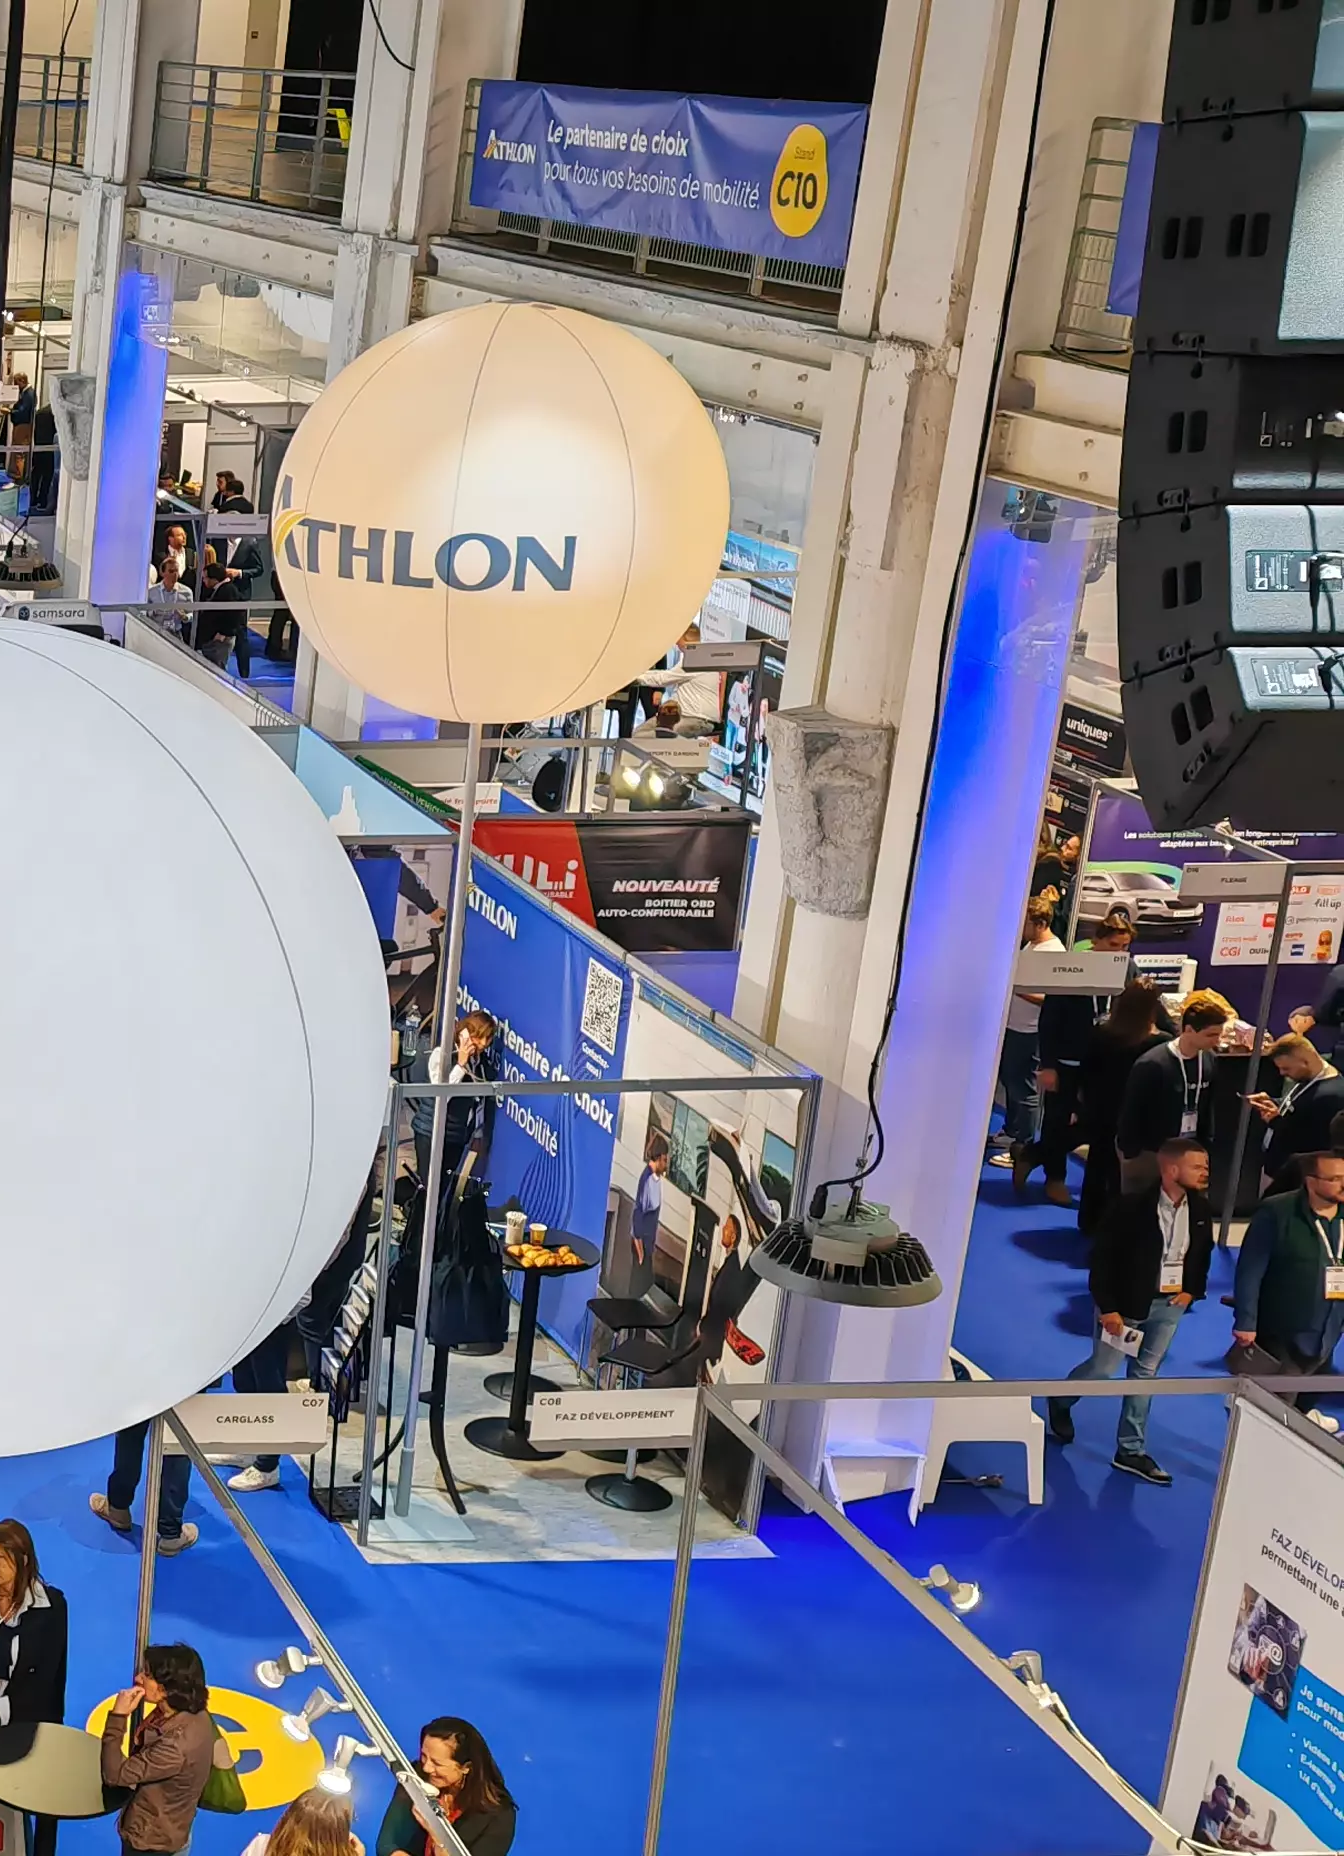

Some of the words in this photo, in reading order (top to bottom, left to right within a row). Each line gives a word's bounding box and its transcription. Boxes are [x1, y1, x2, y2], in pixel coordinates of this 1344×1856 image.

[483, 129, 536, 165] ATHLON
[548, 119, 562, 143] Le
[564, 126, 627, 152] partenaire
[630, 130, 647, 152] de
[652, 131, 689, 157] choix
[544, 160, 571, 185] pour
[572, 160, 598, 186] tous
[602, 169, 624, 189] vos
[627, 166, 676, 197] besoins
[680, 175, 700, 199] de
[704, 179, 760, 210] mobilité.
[777, 171, 818, 210] C10
[274, 474, 577, 592] ATHLON
[33, 608, 85, 619] samsara
[1124, 831, 1137, 840] Les
[612, 877, 720, 893] NOUVEAUTÉ
[597, 908, 714, 918] AUTO-CONFIGURABLE
[645, 899, 688, 908] BOITIER
[691, 899, 715, 908] OBD
[1330, 900, 1342, 910] up
[456, 984, 480, 1011] otre
[507, 1096, 558, 1158] mobilité
[302, 1398, 325, 1408] C07
[539, 1397, 562, 1406] C08
[216, 1415, 275, 1424] CARGLASS
[555, 1412, 577, 1422] FAZ
[580, 1409, 675, 1421] DÉVELOPPEMENT
[1271, 1527, 1292, 1553] FAZ
[1261, 1543, 1318, 1596] permettant
[1319, 1587, 1340, 1611] une
[1297, 1701, 1321, 1724] pour
